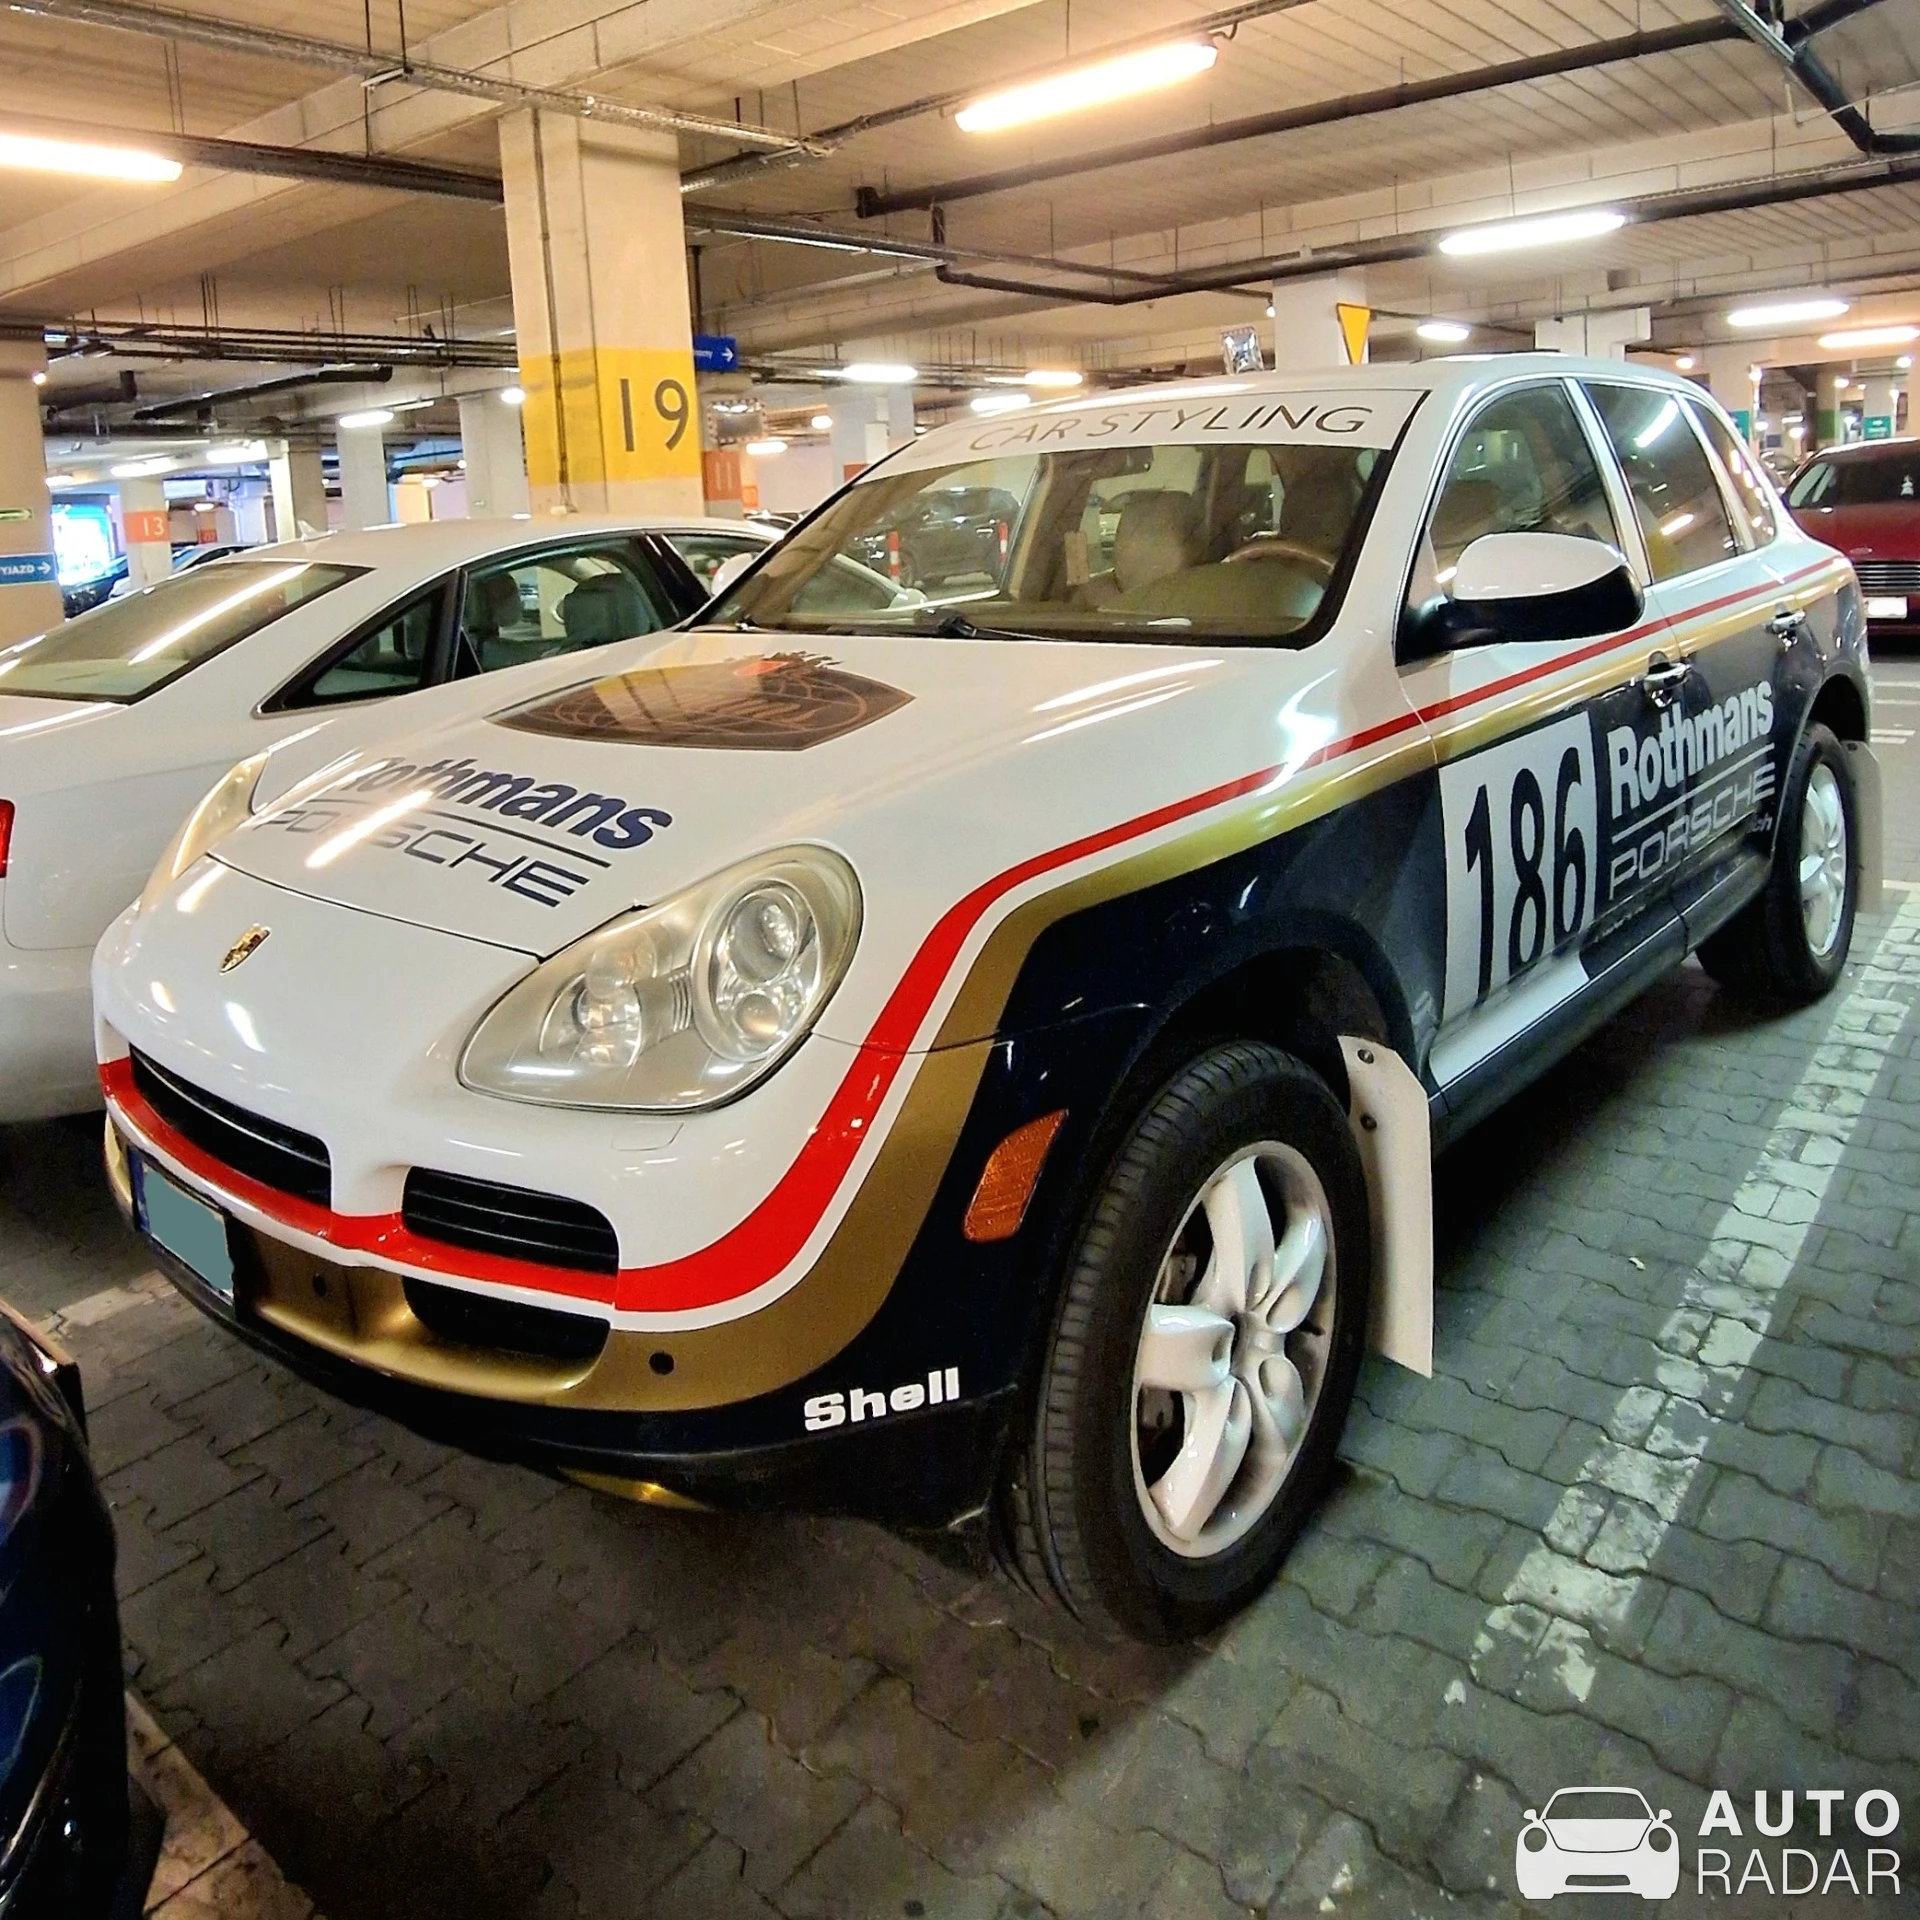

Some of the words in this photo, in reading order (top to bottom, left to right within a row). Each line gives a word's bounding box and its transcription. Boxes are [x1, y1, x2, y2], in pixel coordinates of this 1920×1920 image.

[619, 378, 689, 451] 19
[969, 418, 1082, 452] CAR
[1085, 404, 1374, 437] STYLING
[143, 517, 165, 537] 13
[0, 564, 36, 576] YJAZD
[1607, 680, 1774, 820] Rothmans
[252, 810, 591, 908] POSCHE
[1608, 762, 1776, 901] PORSCHE
[1464, 747, 1587, 1008] 186
[803, 1367, 960, 1432] Shell
